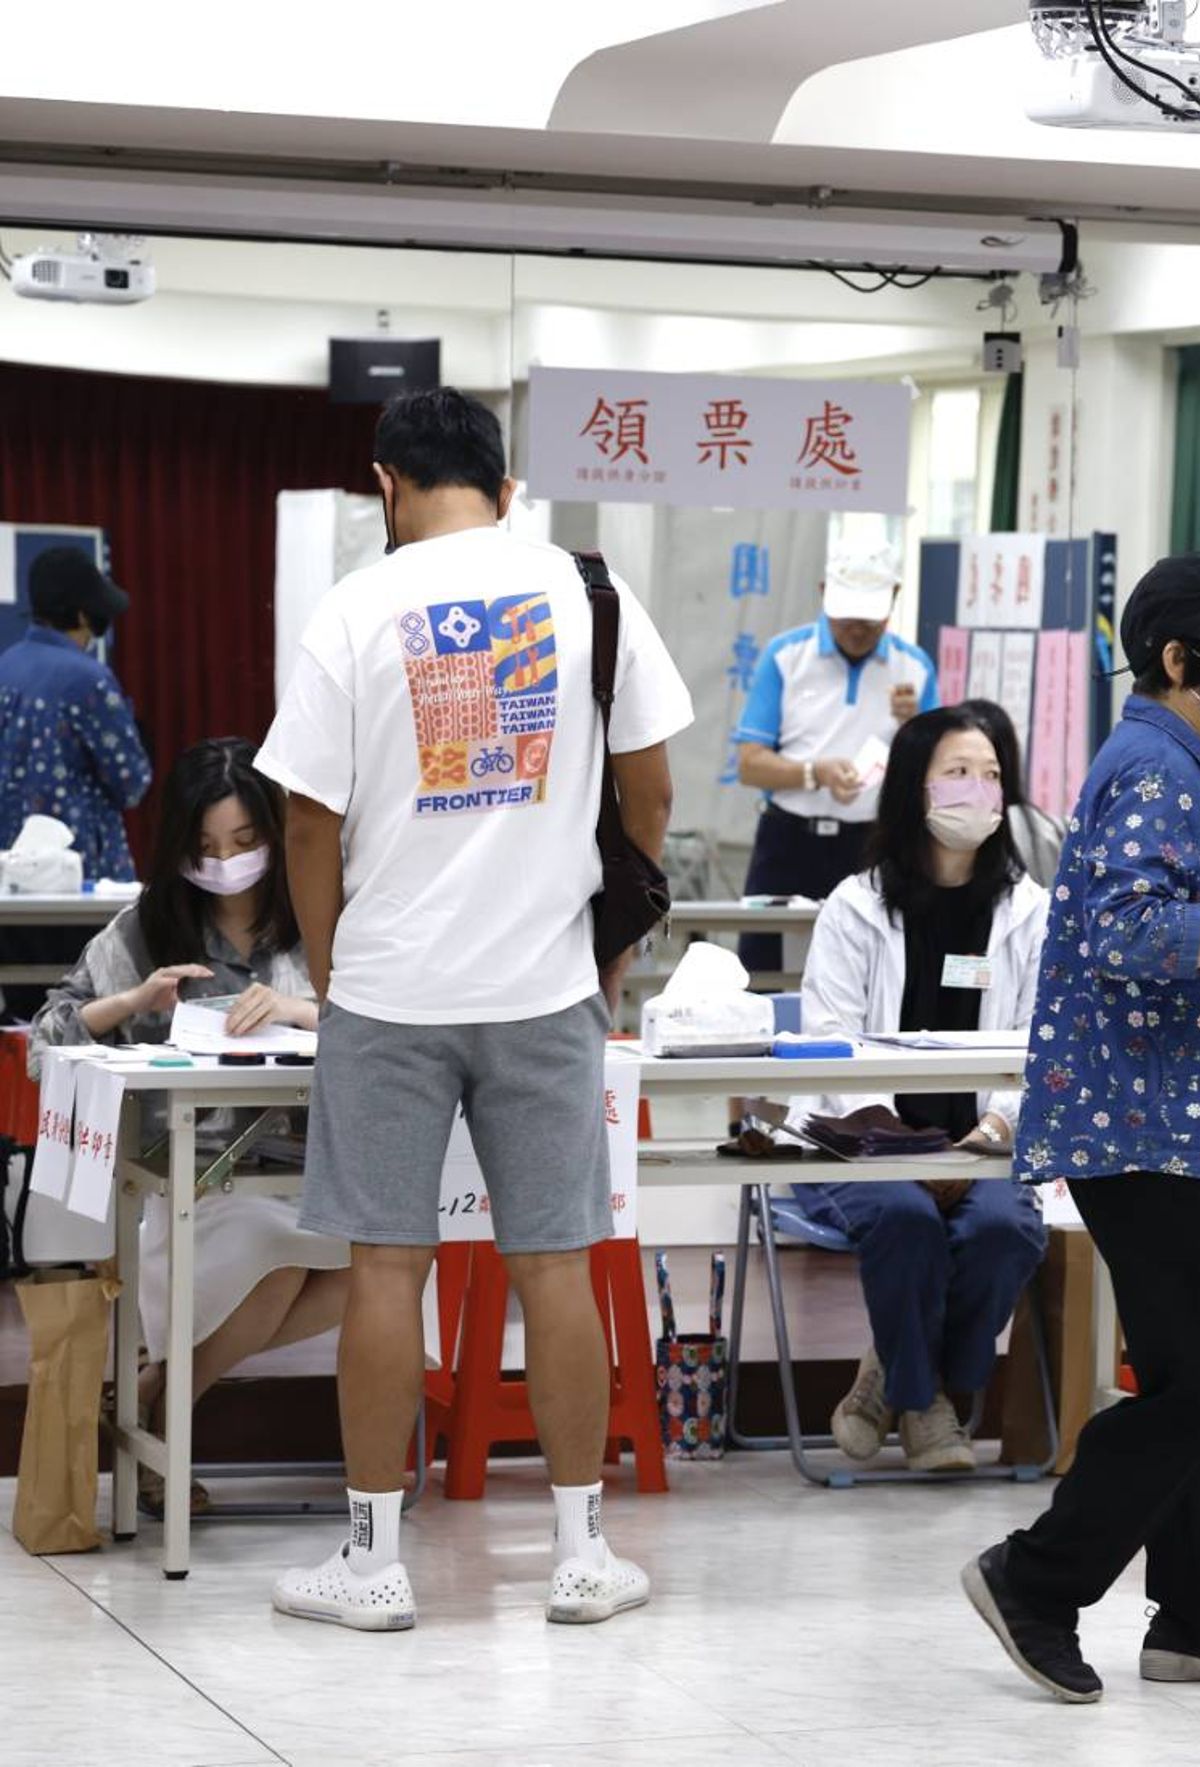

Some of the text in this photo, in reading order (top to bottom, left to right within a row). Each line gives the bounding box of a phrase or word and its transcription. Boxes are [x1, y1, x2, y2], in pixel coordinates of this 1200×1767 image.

[580, 397, 863, 475] 領票處
[499, 695, 556, 710] TAIWAN
[500, 707, 556, 722] TAIWAN
[501, 719, 556, 734] TAIWAN
[416, 786, 532, 812] FRONTIER
